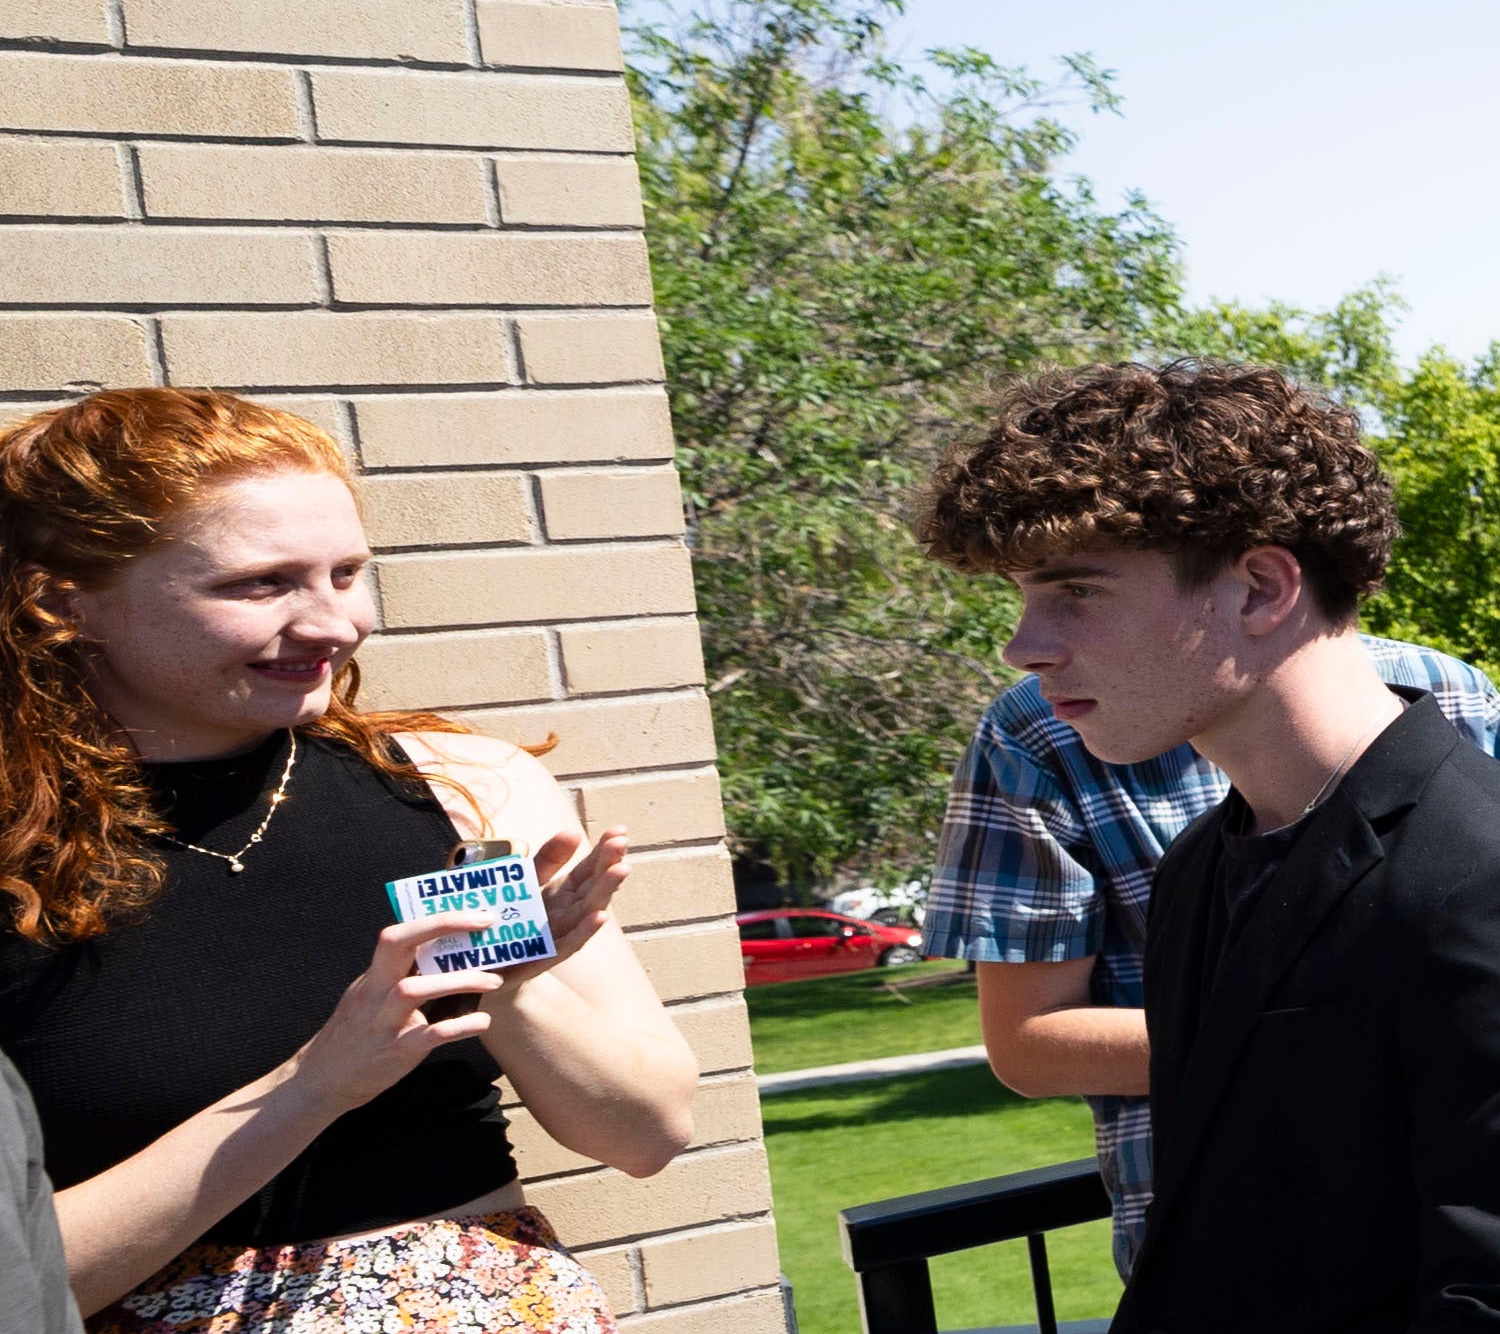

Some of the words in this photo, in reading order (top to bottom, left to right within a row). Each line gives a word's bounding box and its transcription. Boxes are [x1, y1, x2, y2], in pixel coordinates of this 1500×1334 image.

[418, 863, 525, 898] CLIMATE!
[502, 882, 532, 904] TO
[422, 891, 480, 915] SAFE
[486, 889, 498, 907] A
[469, 919, 543, 948] YOUTH
[434, 936, 548, 973] MONTANA
